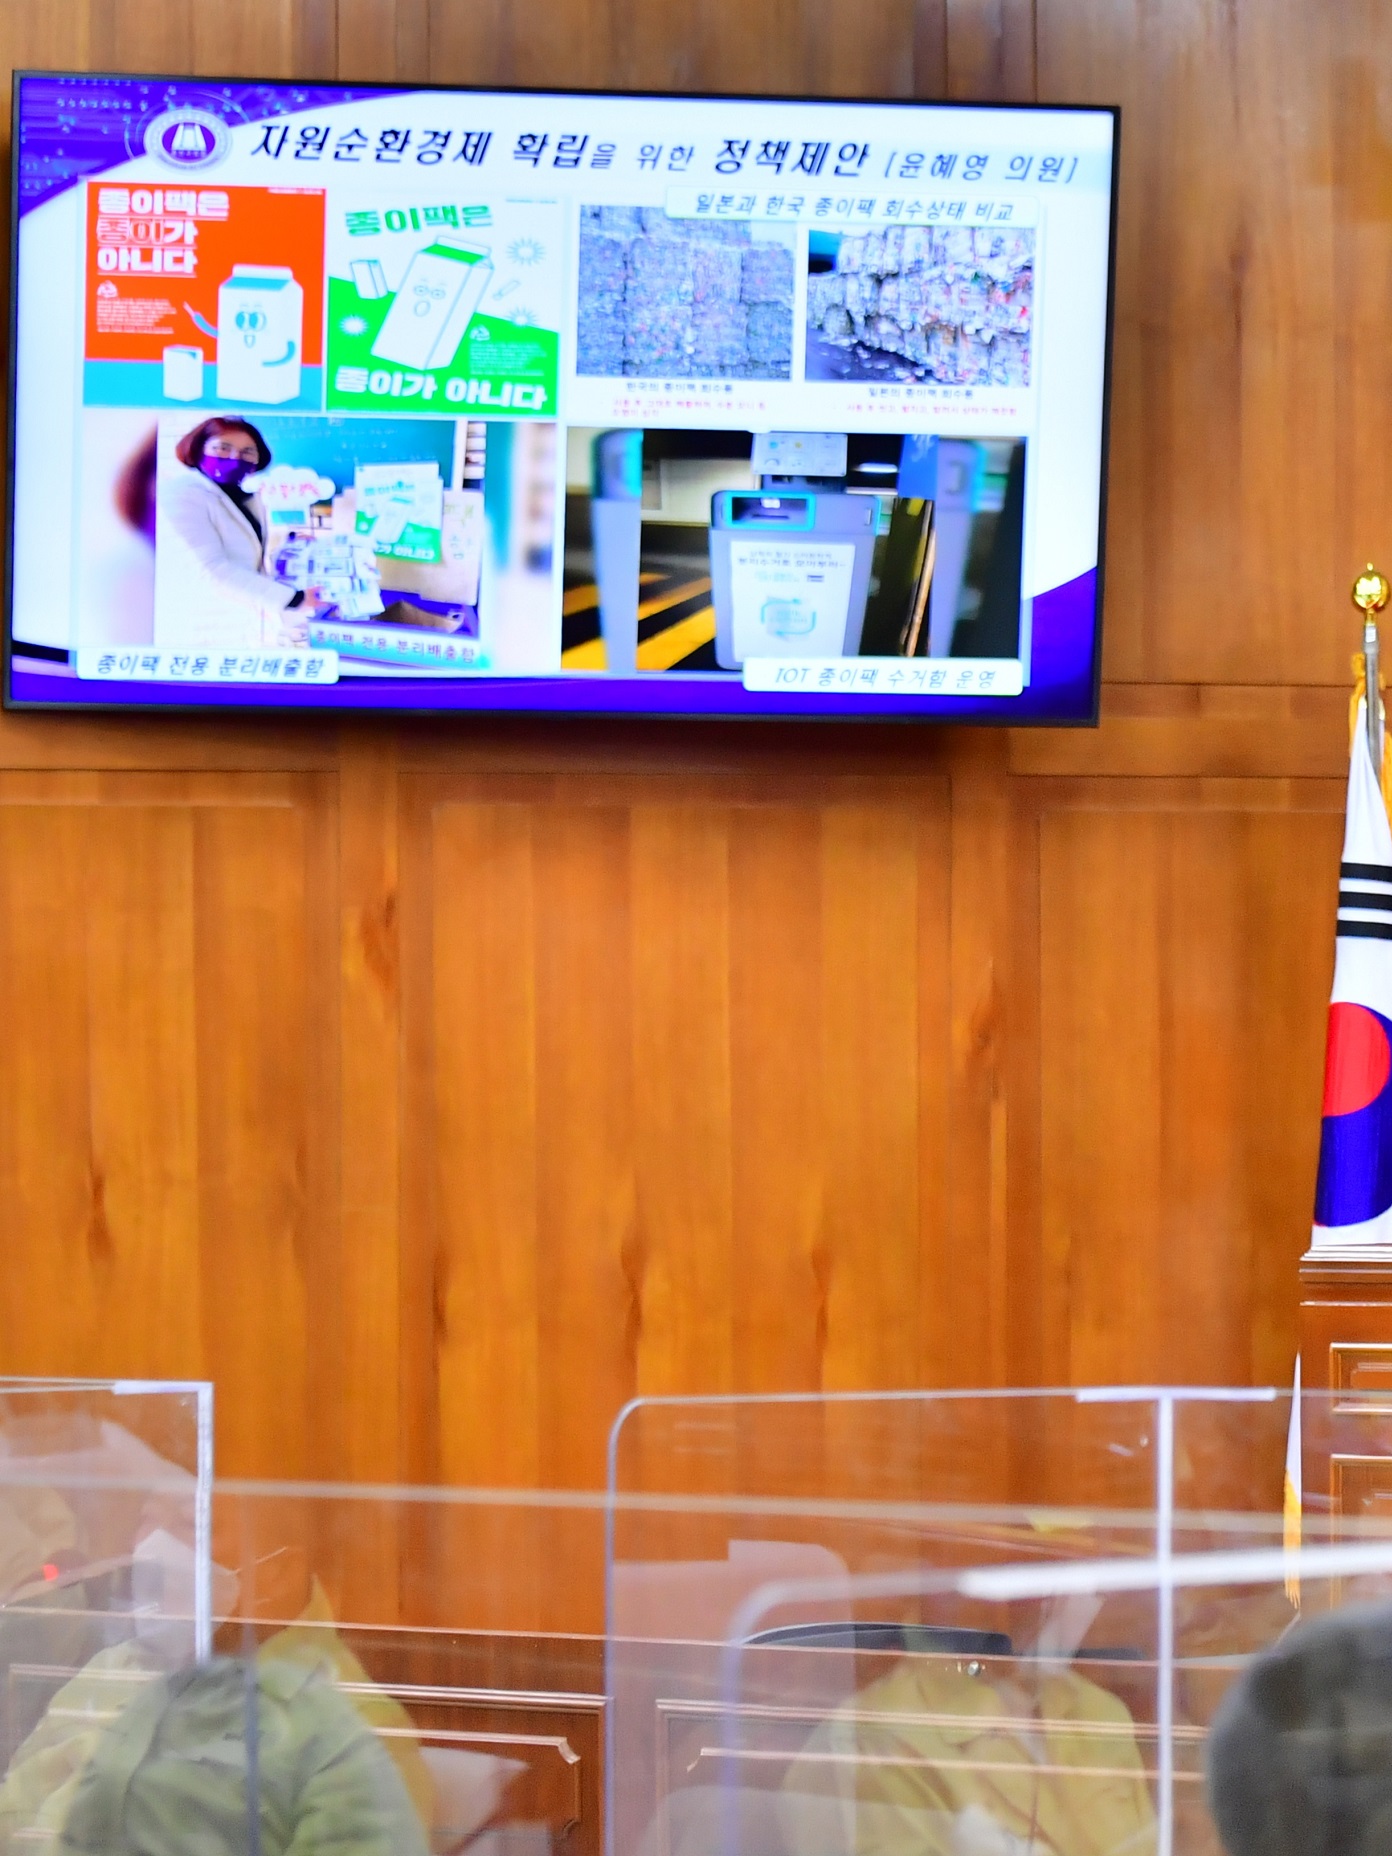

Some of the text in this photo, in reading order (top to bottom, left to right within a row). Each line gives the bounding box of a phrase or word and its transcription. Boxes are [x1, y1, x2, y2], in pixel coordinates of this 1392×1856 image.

[250, 123, 493, 167] 자원순환경제
[512, 131, 617, 170] 확립을
[637, 143, 695, 173] 위한
[714, 138, 870, 177] 정책제안
[98, 187, 229, 218] 종이팩은
[695, 193, 1014, 222] 일본과 한국 종이팩 회수상태 비교
[96, 218, 198, 246] 종이가
[345, 204, 493, 236] 종이팩은
[97, 247, 198, 273] 아니다
[335, 365, 548, 411] 종이가 아니다
[97, 654, 326, 679] 종이팩 전용 분리배출함
[774, 668, 996, 689] IOT 종이팩 수거함 운영
